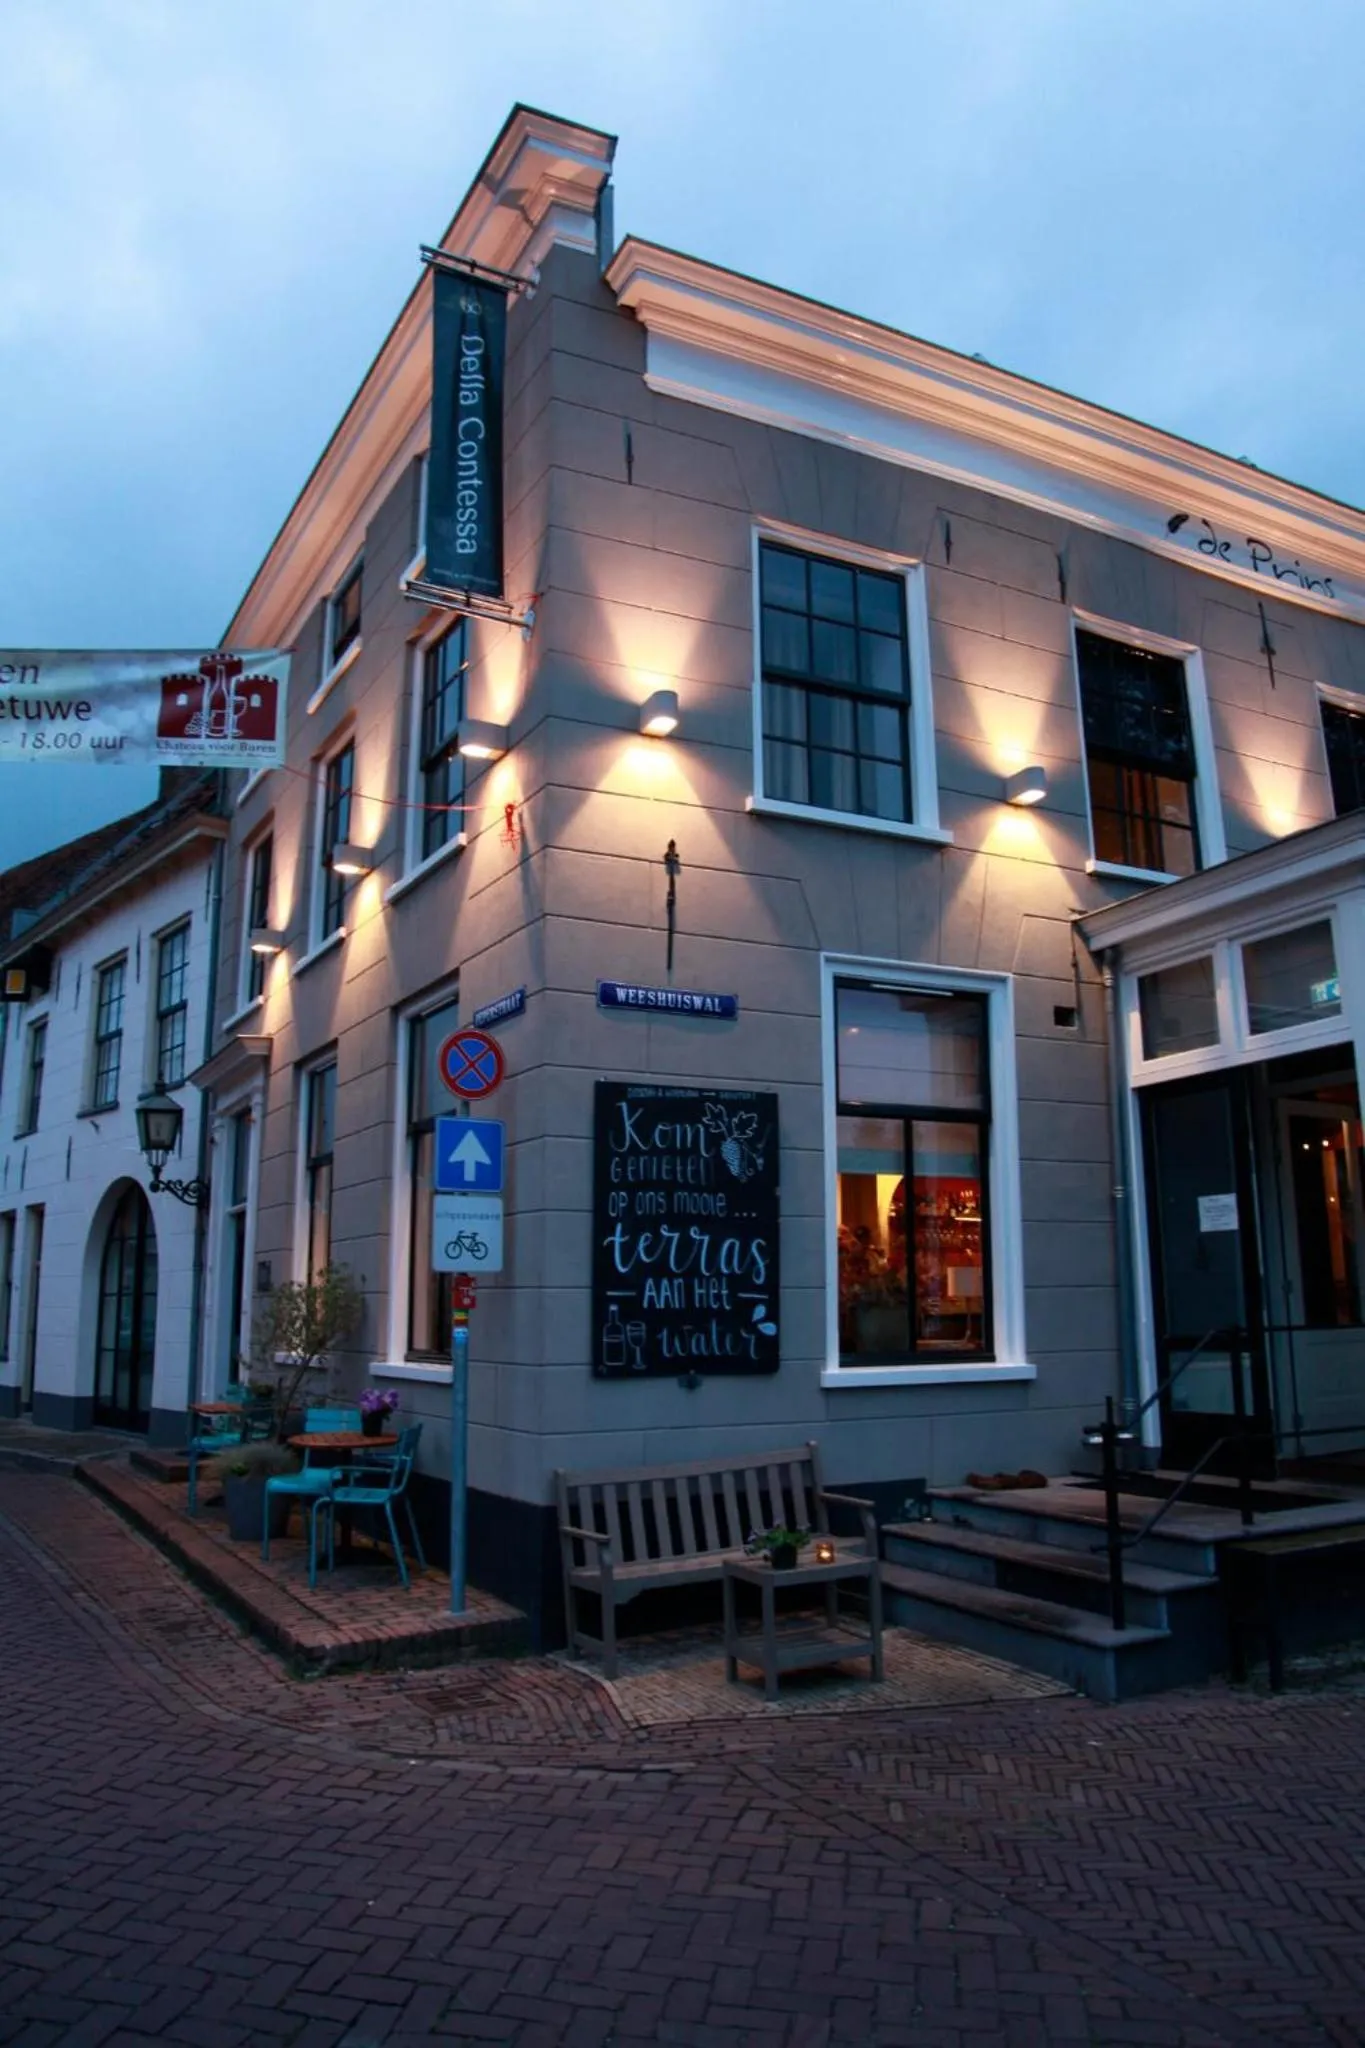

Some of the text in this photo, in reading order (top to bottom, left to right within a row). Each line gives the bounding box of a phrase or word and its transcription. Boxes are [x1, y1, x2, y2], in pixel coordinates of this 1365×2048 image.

[459, 335, 485, 405] Della
[456, 417, 485, 554] Contessa
[1197, 518, 1335, 599] de Prins
[20, 731, 82, 749] 18.00
[90, 735, 128, 749] uur
[616, 987, 722, 1013] WEESHUISWAL
[609, 1101, 715, 1158] Kom
[603, 1222, 769, 1285] terras
[657, 1318, 759, 1360] water
